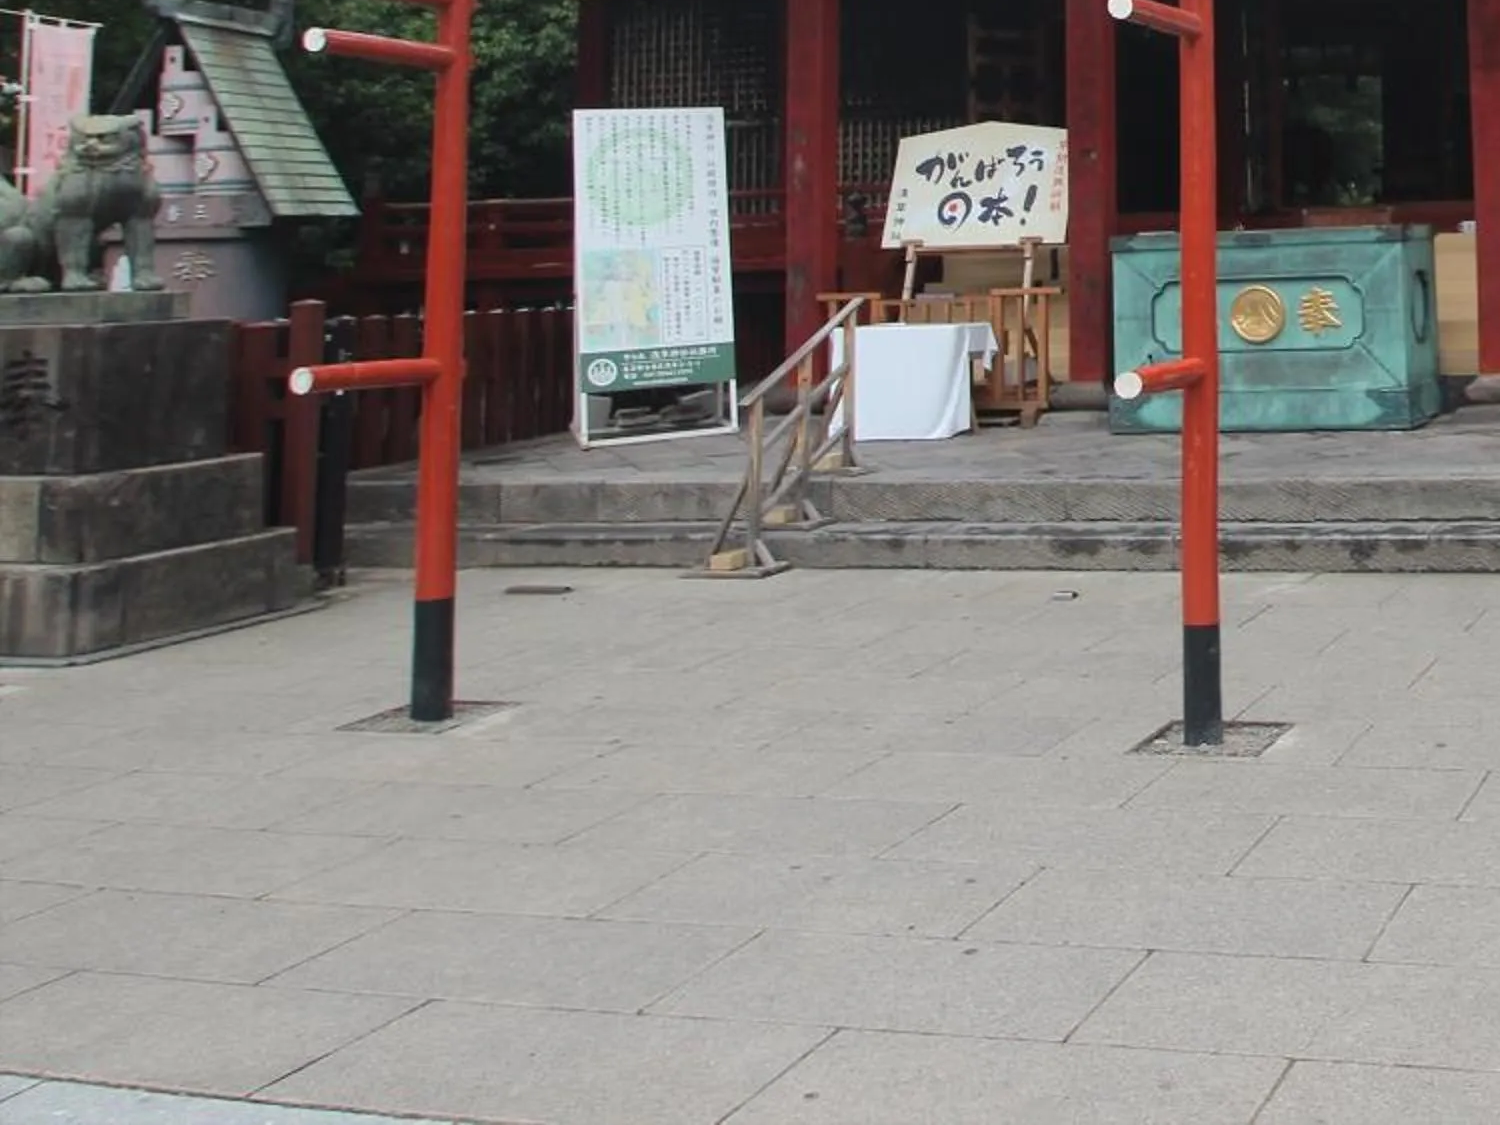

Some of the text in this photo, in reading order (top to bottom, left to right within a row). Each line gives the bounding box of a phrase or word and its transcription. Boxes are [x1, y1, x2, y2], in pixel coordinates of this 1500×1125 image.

[915, 144, 1044, 189] がんばろう
[1297, 286, 1343, 339] 奉
